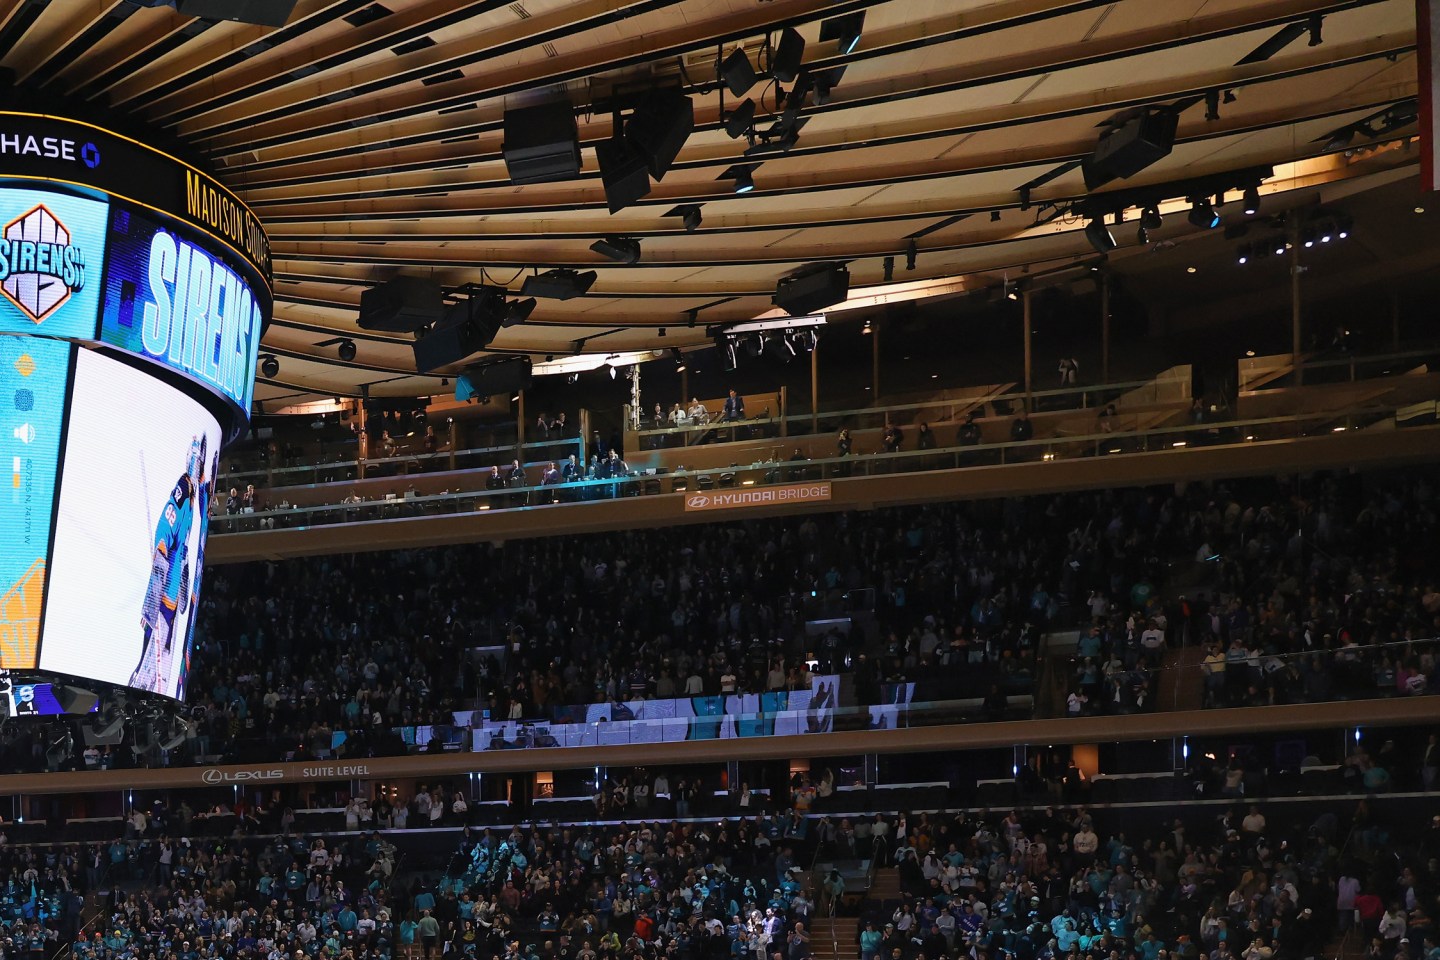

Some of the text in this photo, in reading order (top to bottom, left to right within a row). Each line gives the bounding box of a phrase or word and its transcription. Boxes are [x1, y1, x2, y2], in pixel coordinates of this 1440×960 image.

[186, 169, 244, 247] MADISON
[142, 231, 251, 401] SIRENS
[713, 486, 829, 505] HYUNDAI BRIDGE
[224, 765, 370, 780] LEXUS SUITE LEVEL
